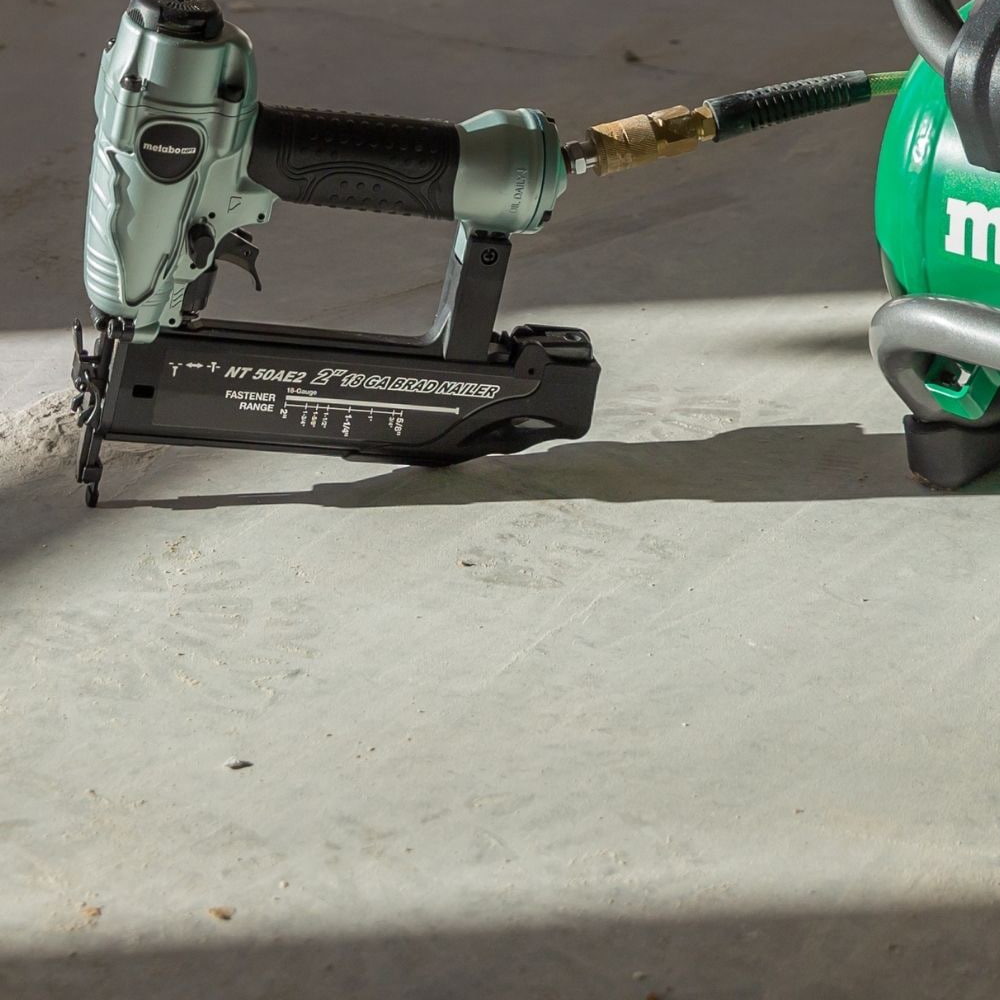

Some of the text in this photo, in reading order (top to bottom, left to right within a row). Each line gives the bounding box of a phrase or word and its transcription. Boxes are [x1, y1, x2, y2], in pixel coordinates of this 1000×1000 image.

[143, 142, 181, 154] metabo
[224, 366, 253, 379] NT
[252, 368, 308, 384] 50AE2
[341, 373, 365, 387] 18
[363, 373, 392, 390] GA
[387, 377, 439, 394] BRAD
[437, 380, 501, 399] NAILER
[225, 389, 277, 402] FASTENER
[239, 401, 275, 413] RANGE
